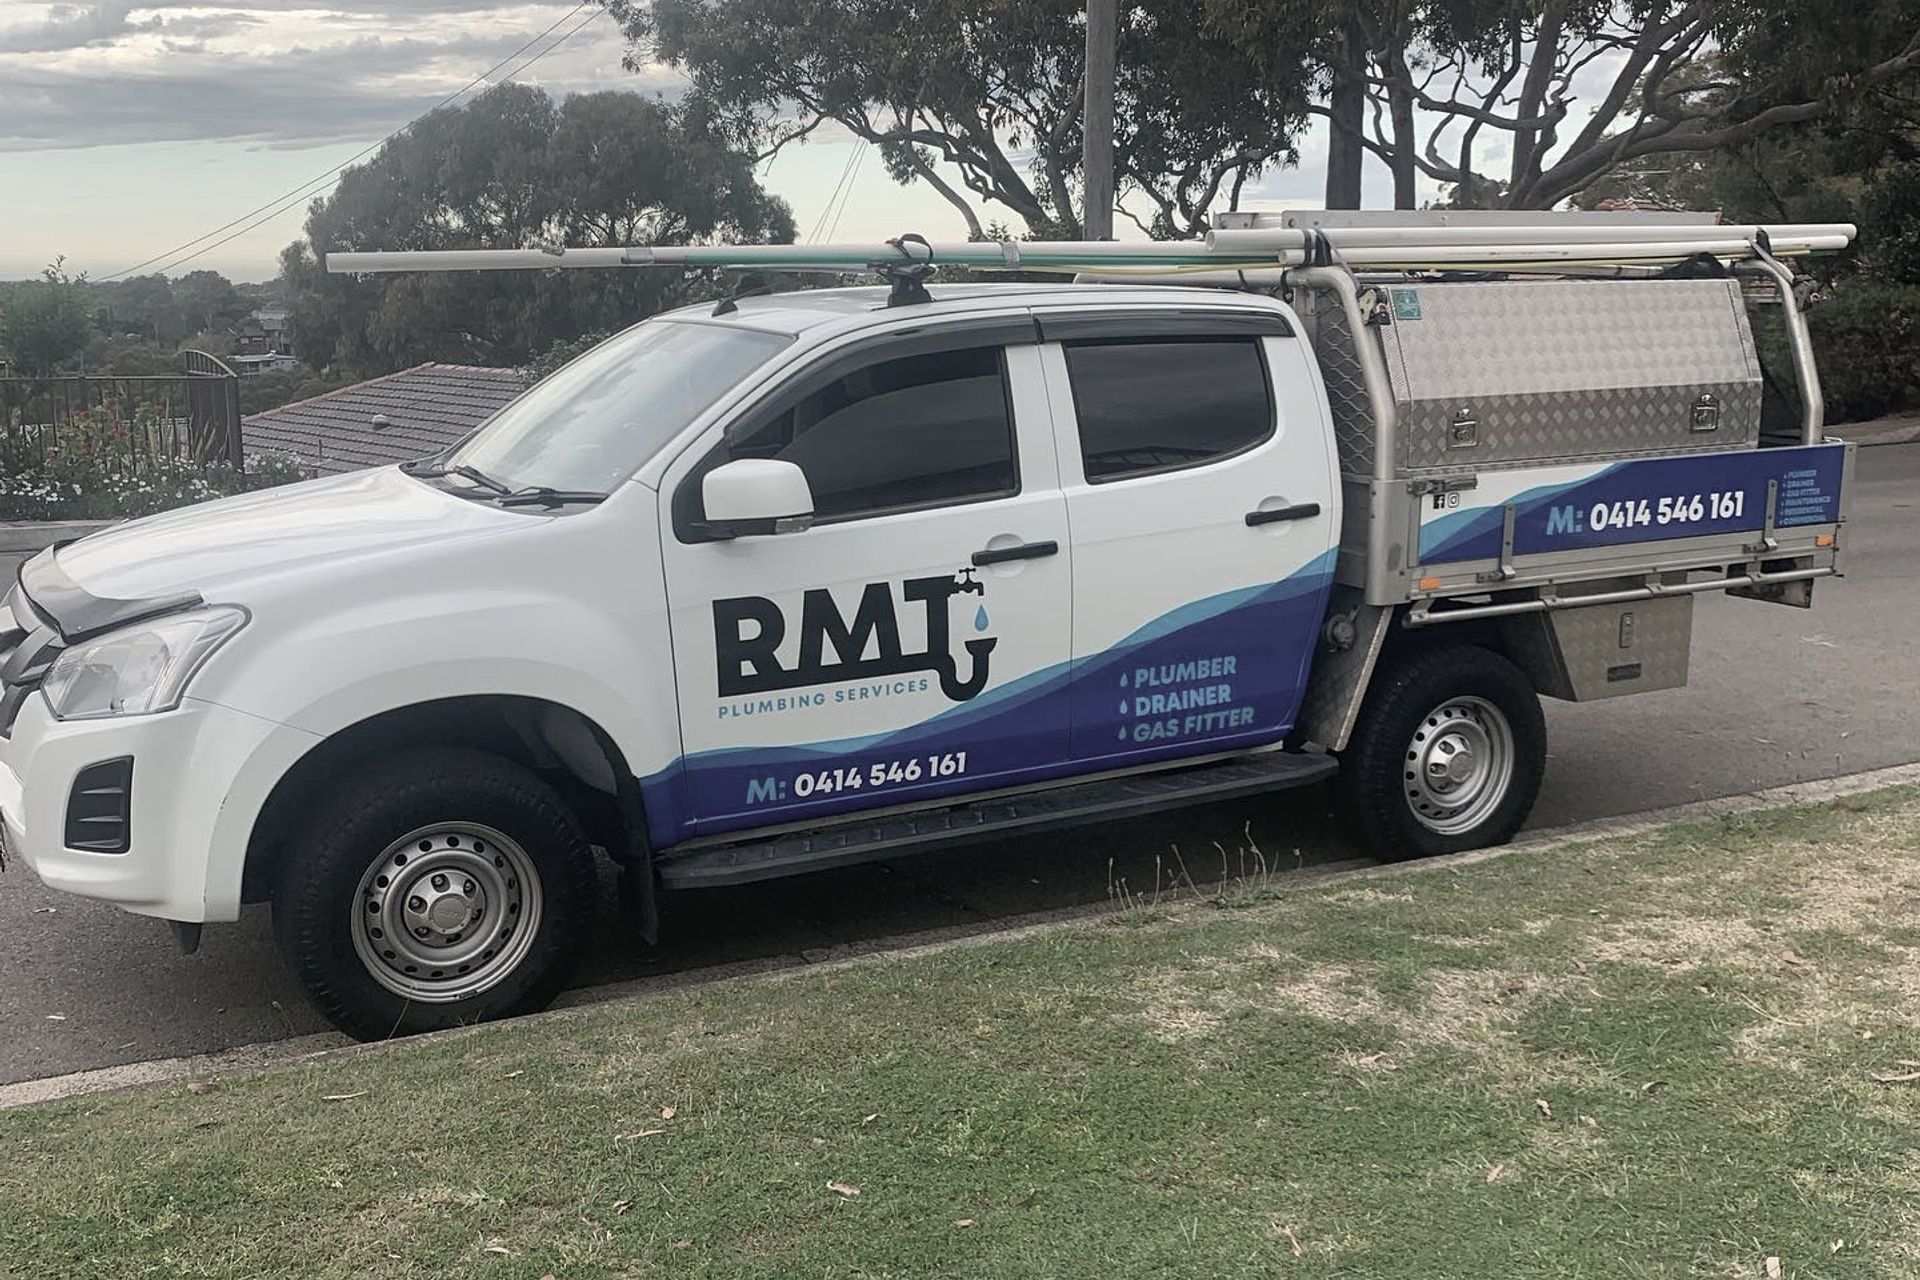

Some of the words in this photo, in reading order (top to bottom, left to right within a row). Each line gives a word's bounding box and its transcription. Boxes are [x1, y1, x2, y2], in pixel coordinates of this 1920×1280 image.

[1546, 505, 1583, 535] M:
[1590, 499, 1650, 531] 0414
[1657, 494, 1704, 524] 546
[1710, 491, 1744, 519] 161
[712, 573, 998, 702] RMT
[1134, 655, 1237, 689] PLUMBER
[718, 692, 826, 719] PLUMBING
[834, 679, 929, 703] SERVICES
[1135, 684, 1232, 717] DRAINER
[1133, 718, 1180, 742] GAS
[1184, 707, 1254, 735] FITTER
[746, 777, 786, 804] M:
[794, 767, 862, 797] 0414
[869, 759, 921, 786] 546
[929, 752, 966, 777] 161
